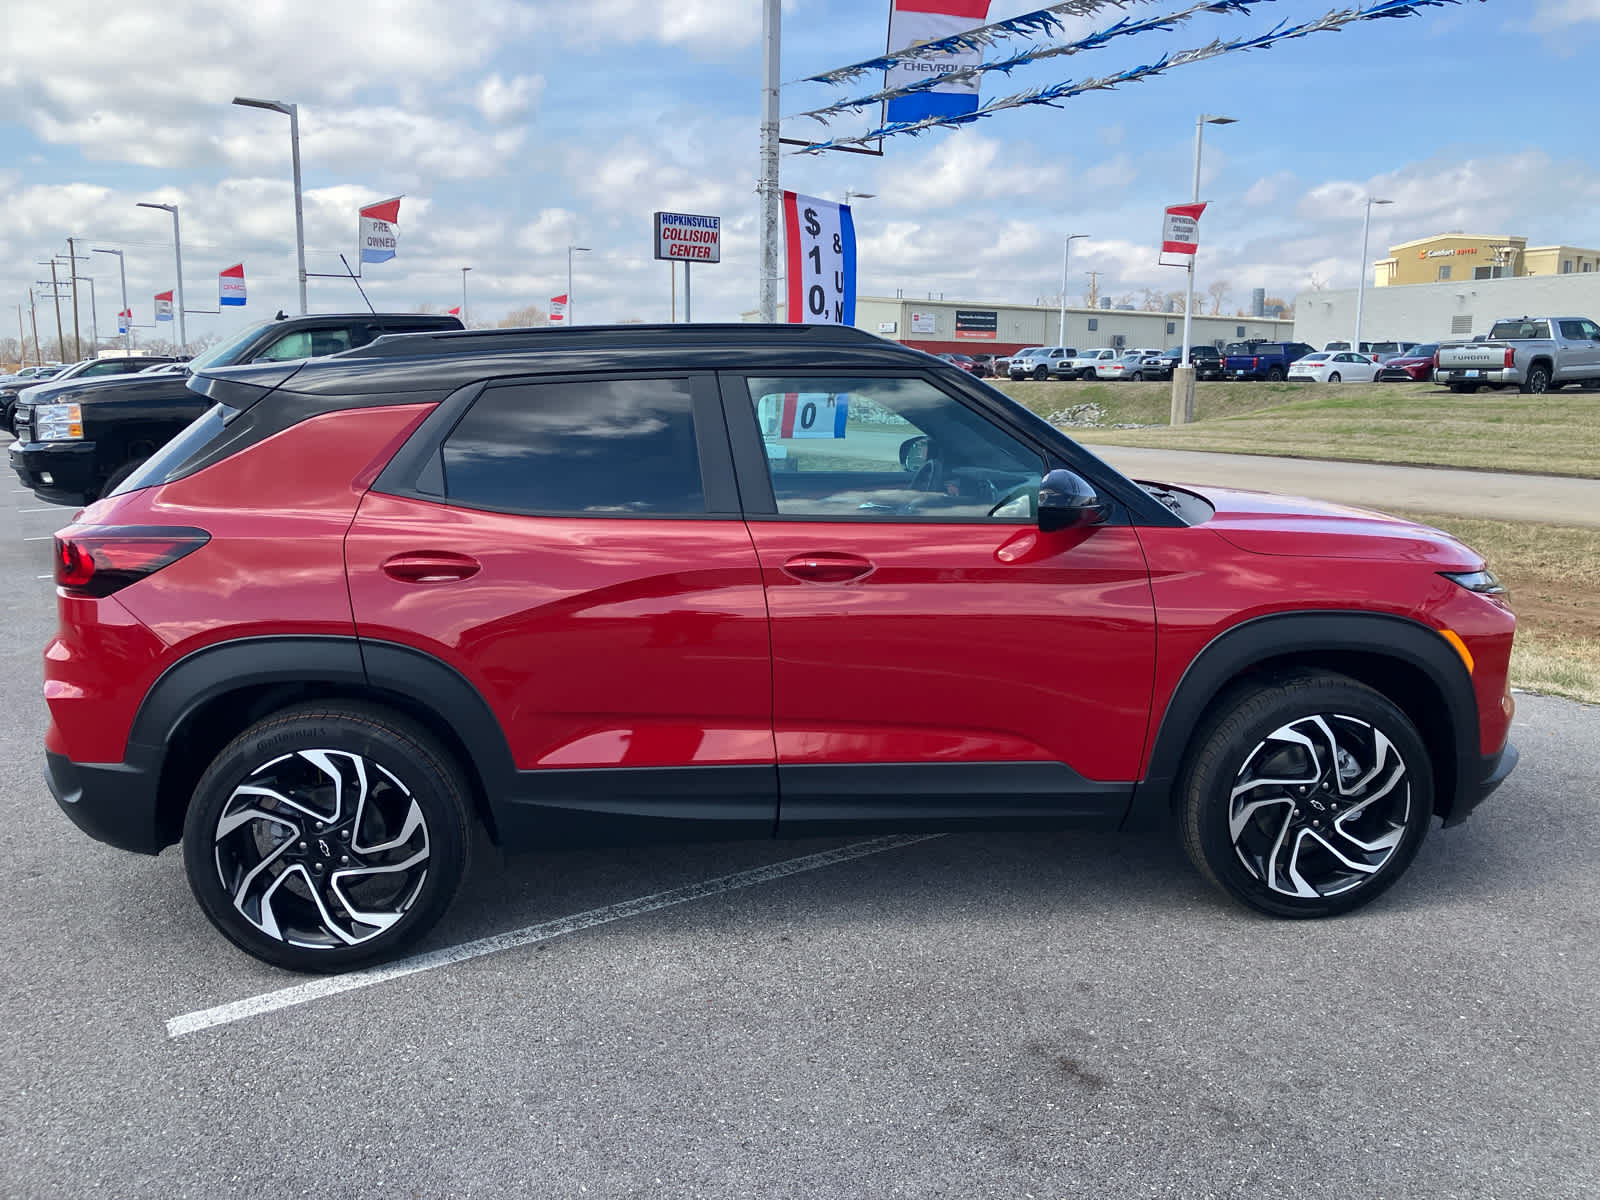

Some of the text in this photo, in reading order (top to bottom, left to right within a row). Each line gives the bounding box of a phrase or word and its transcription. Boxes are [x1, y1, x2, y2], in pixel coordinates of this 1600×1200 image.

[373, 222, 389, 233] PRE
[662, 214, 718, 229] HOPKINSVILLE
[367, 236, 396, 248] OWNED
[662, 227, 718, 244] COLLISION
[669, 243, 711, 258] CENTER
